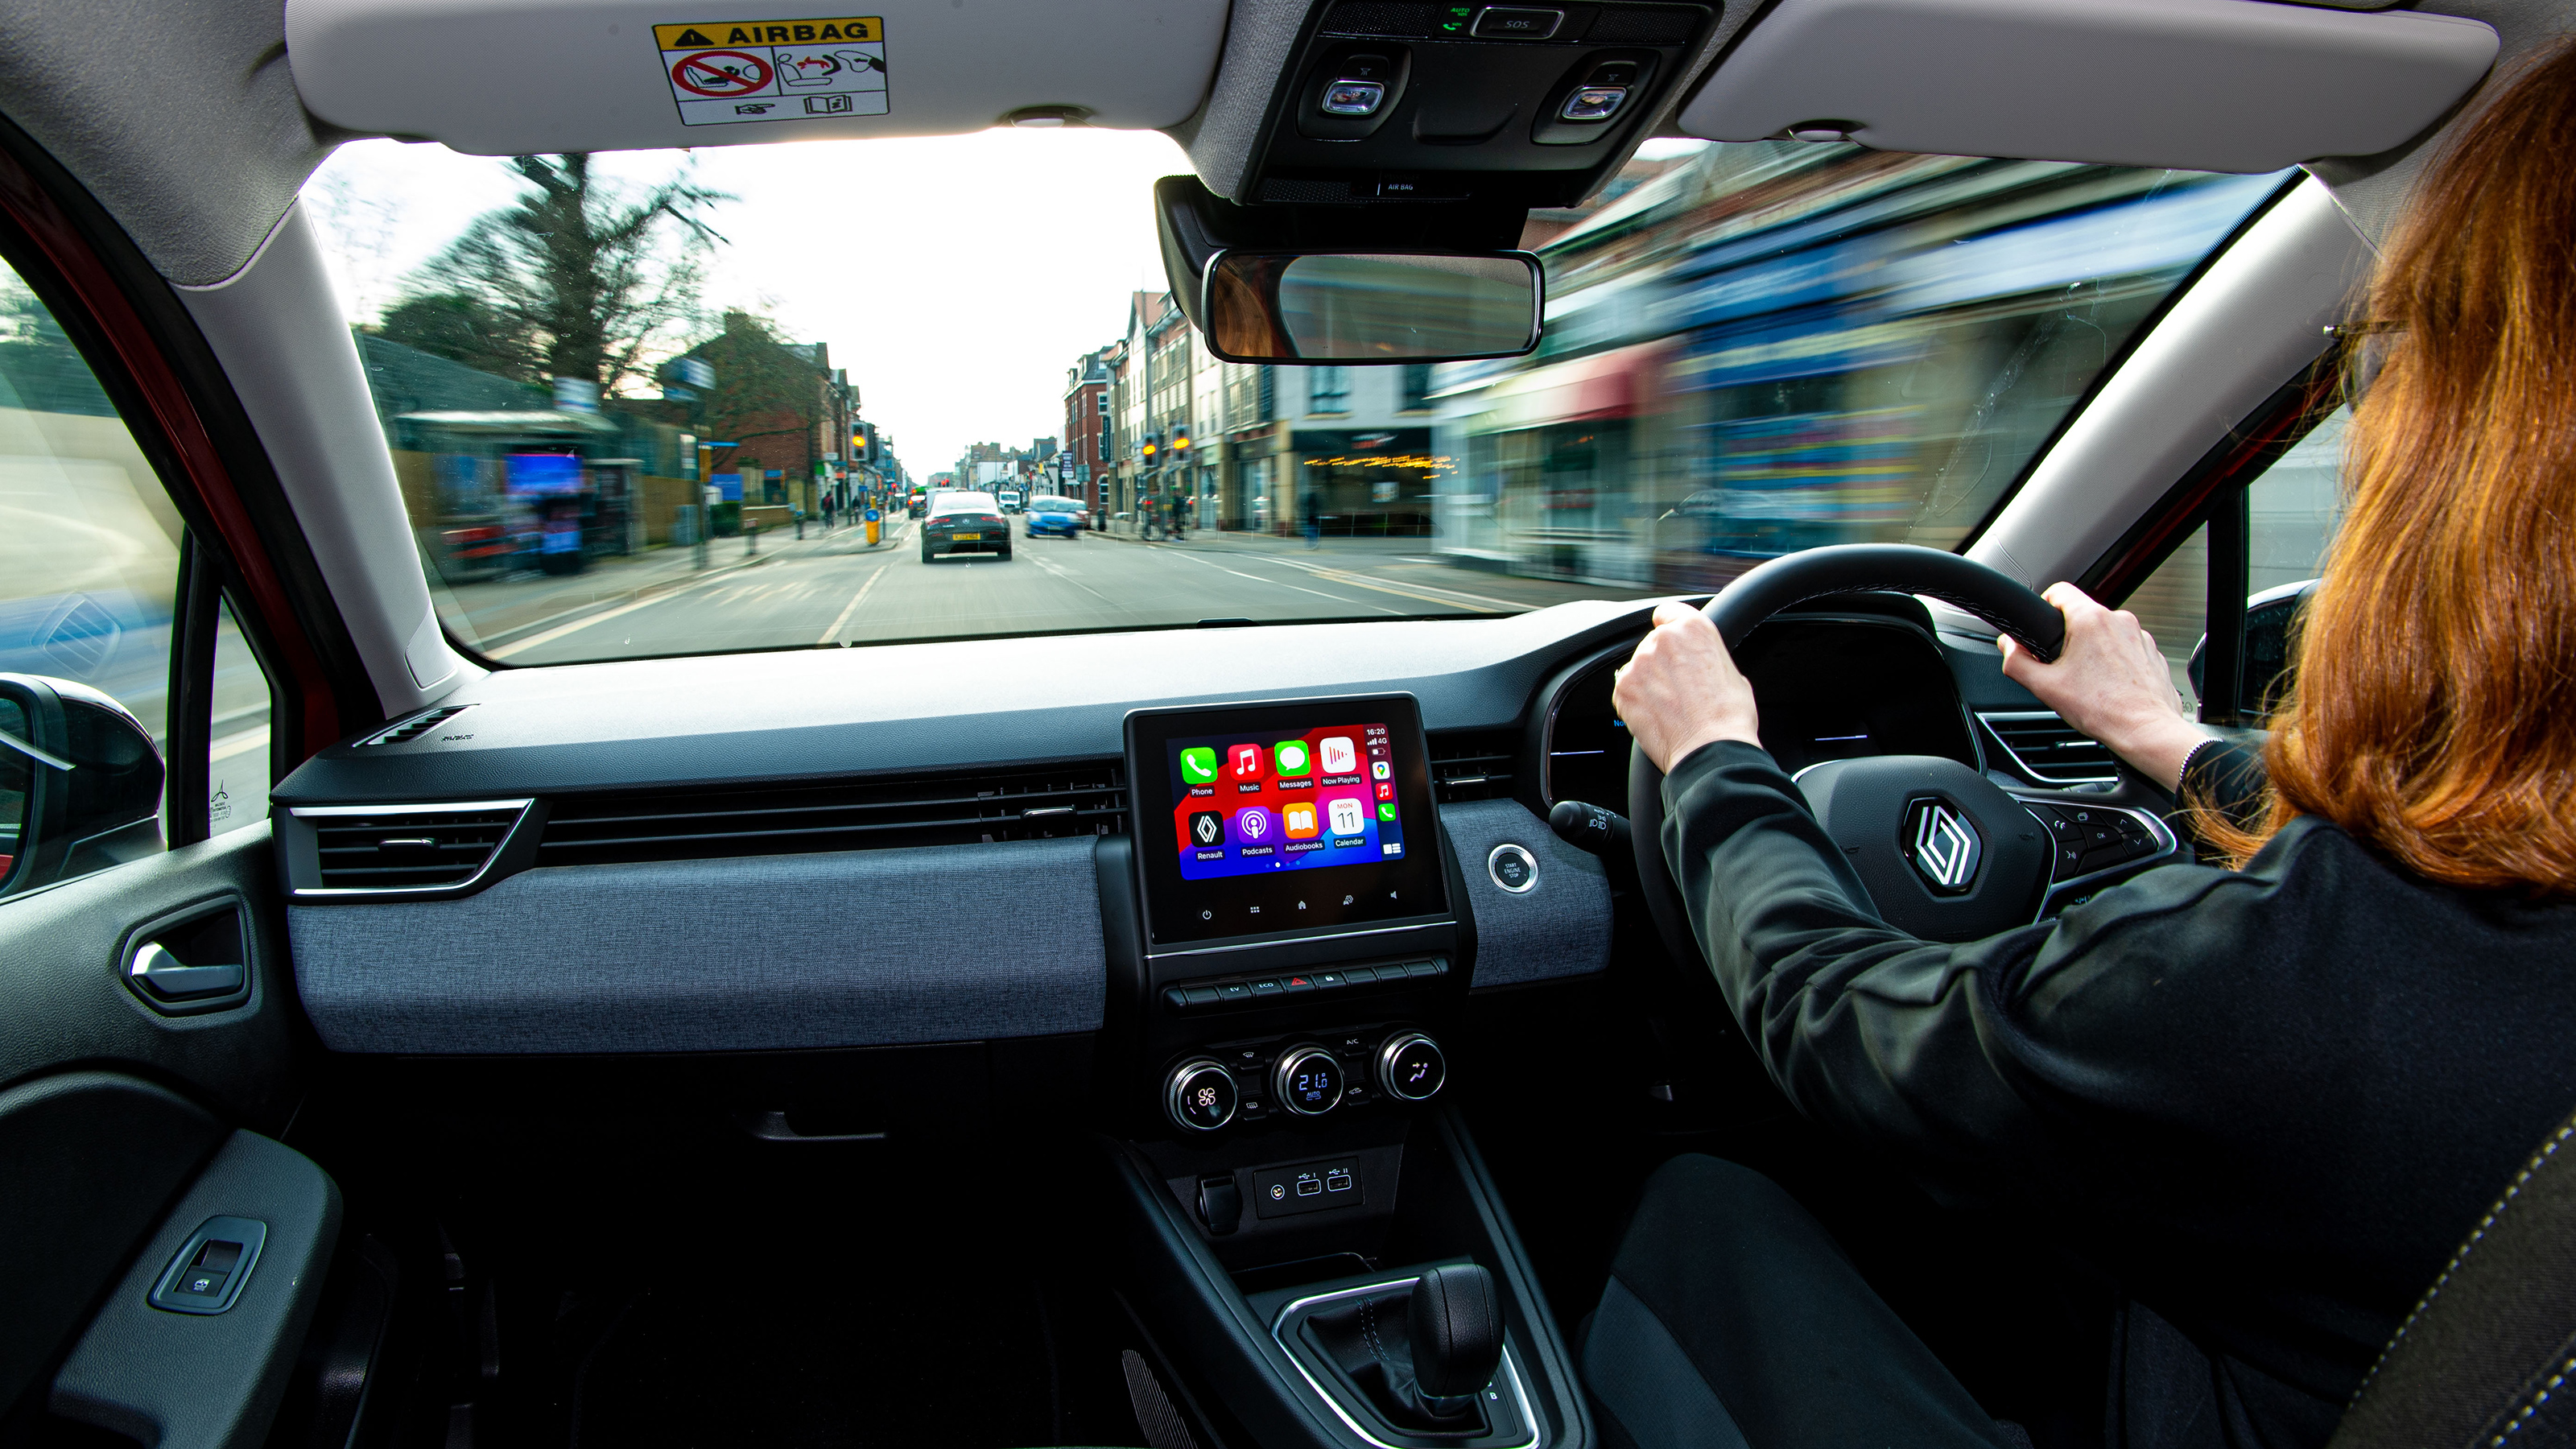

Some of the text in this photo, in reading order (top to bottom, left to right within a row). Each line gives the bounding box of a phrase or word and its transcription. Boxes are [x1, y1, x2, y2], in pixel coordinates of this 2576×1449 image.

[1505, 21, 1530, 29] SOS
[728, 22, 869, 44] AIRBAG
[1279, 780, 1312, 788] Messages
[1337, 776, 1360, 784] Playing
[1338, 811, 1354, 829] 11
[1335, 838, 1364, 846] Calendar
[1285, 842, 1323, 851] Audiobooks
[1197, 851, 1223, 859] Renault
[1242, 847, 1273, 855] Podcasts
[1489, 1391, 1498, 1401] B
